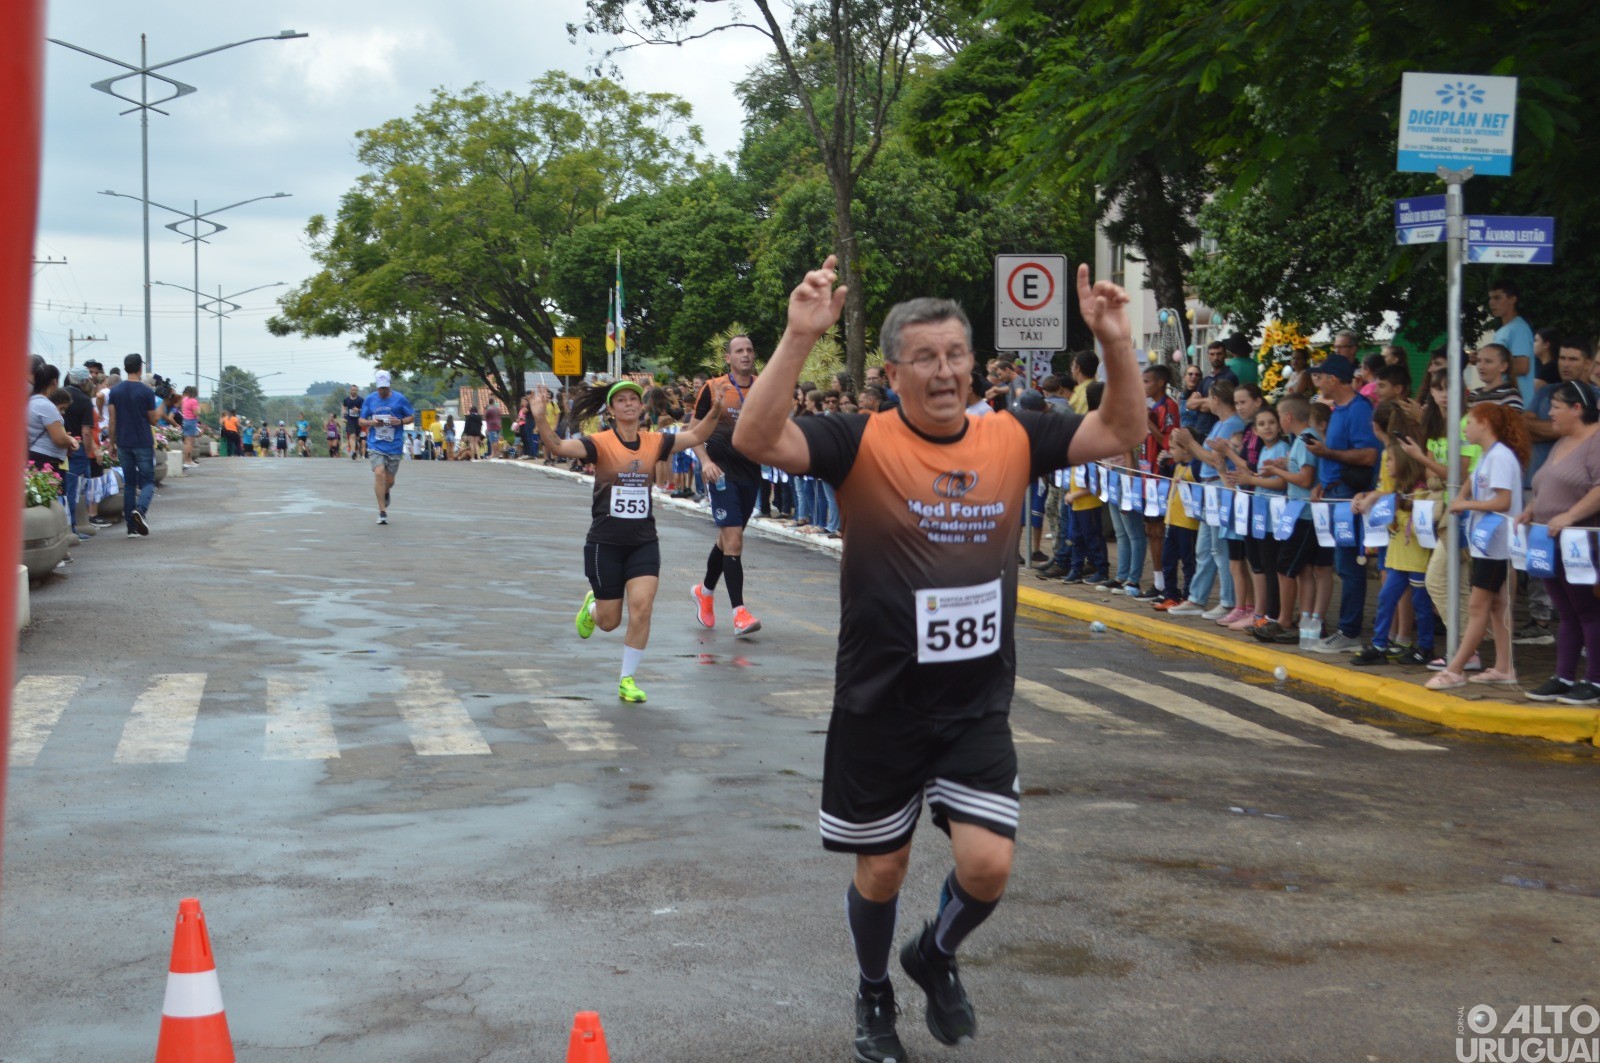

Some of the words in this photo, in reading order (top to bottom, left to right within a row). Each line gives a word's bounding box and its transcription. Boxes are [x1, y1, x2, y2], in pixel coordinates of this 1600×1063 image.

[1408, 109, 1478, 127] DIGIPLAN
[1481, 113, 1509, 129] NET
[1469, 219, 1485, 227] RUA
[1469, 229, 1483, 241] DR.
[1485, 227, 1516, 242] ÁLVARO
[1517, 228, 1545, 243] LEITÃO
[1023, 274, 1038, 299] E
[1002, 317, 1060, 327] EXCLUSIVO
[1019, 329, 1043, 341] TÁXI
[614, 499, 646, 514] 553
[908, 499, 945, 517] Med
[950, 501, 1004, 518] Forma
[918, 518, 996, 531] Academia
[1529, 548, 1547, 559] AGRO
[1564, 559, 1593, 569] Banrisul
[926, 611, 997, 652] 585
